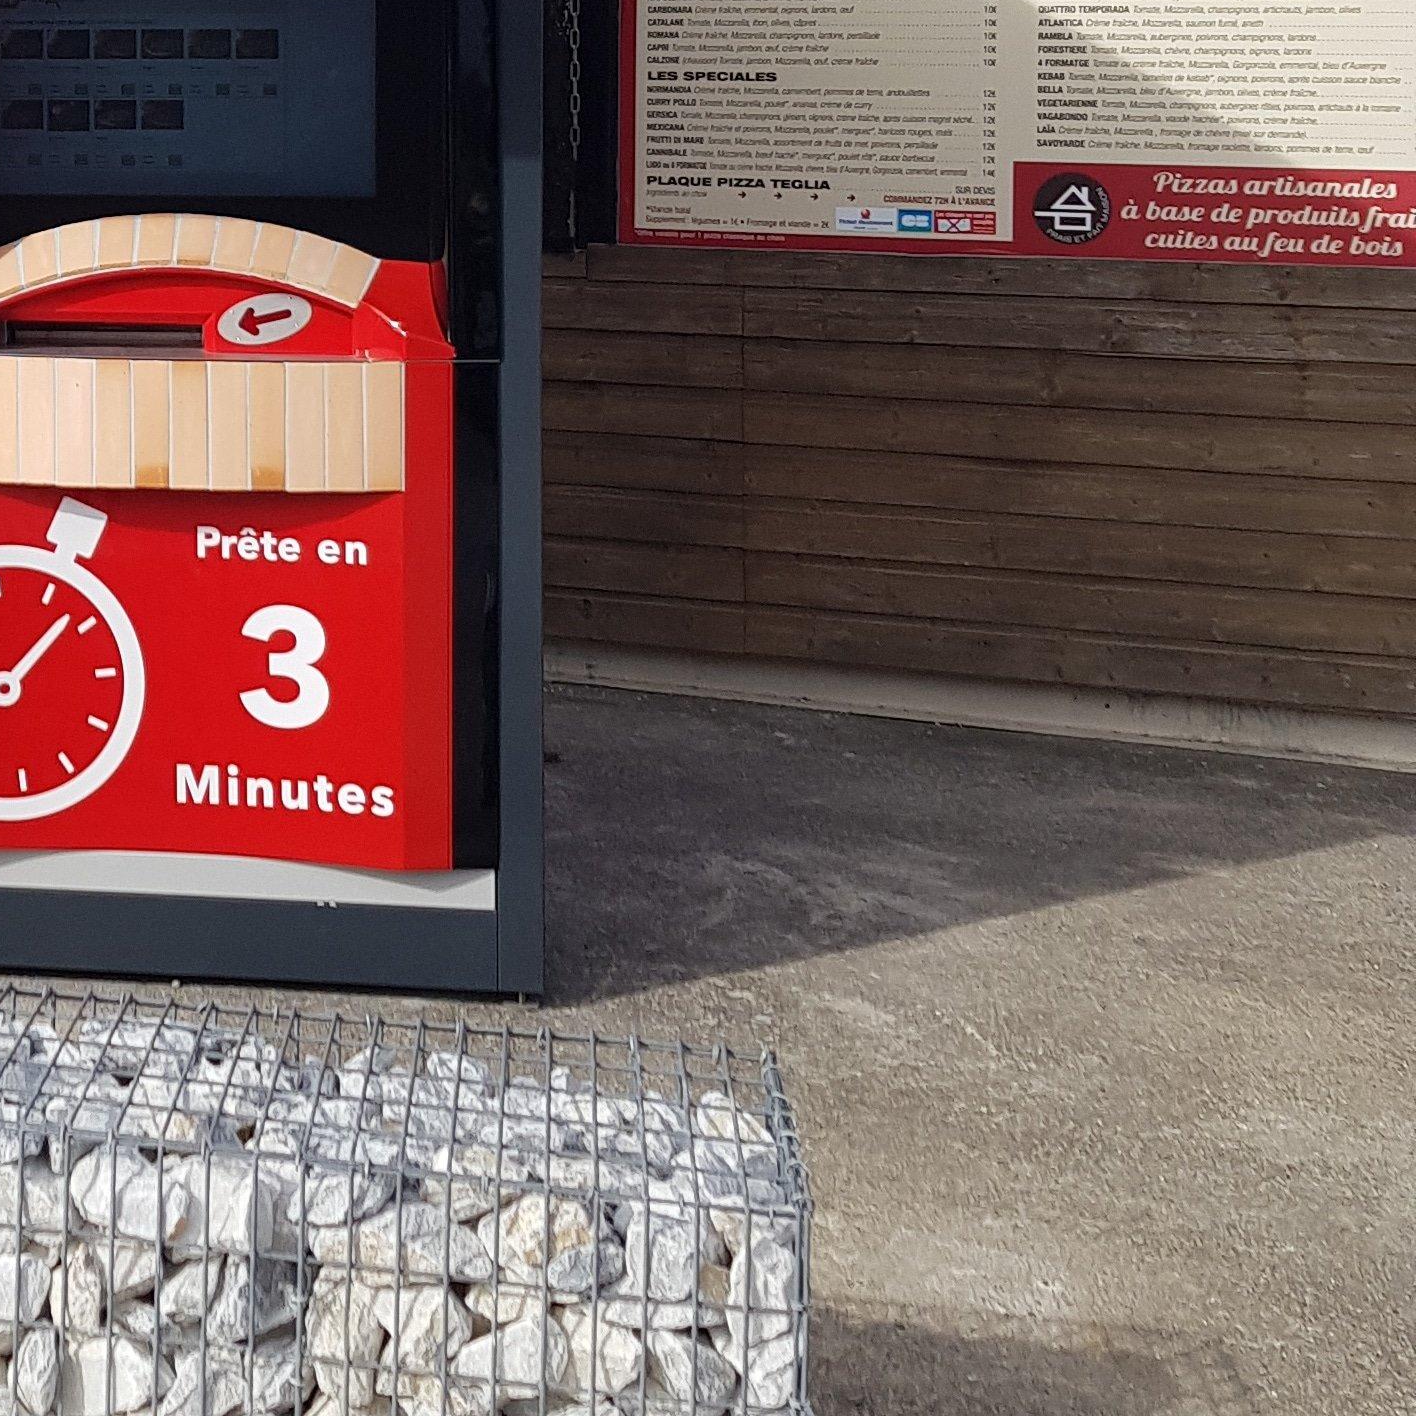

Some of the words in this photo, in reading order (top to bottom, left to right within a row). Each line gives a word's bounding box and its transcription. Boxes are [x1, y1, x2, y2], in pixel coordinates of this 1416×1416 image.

[647, 71, 678, 81] LES
[682, 71, 778, 82] SPECIALES
[646, 175, 712, 188] PLAQUE
[717, 177, 766, 189] PIZZA
[770, 178, 830, 191] TEGLIA
[1152, 171, 1239, 195] Pizzas
[1242, 175, 1399, 200] artisanales
[1120, 199, 1139, 222] à
[1145, 200, 1203, 224] base
[1210, 202, 1241, 225] de
[1245, 203, 1361, 232] produits
[1144, 229, 1219, 251] cuites
[1223, 235, 1258, 252] au
[1257, 232, 1305, 258] feu
[1310, 232, 1343, 254] de
[1348, 233, 1405, 257] bois
[195, 525, 302, 563] Prête
[316, 537, 368, 566] en
[239, 604, 331, 730] 3
[175, 763, 396, 817] Minutes
